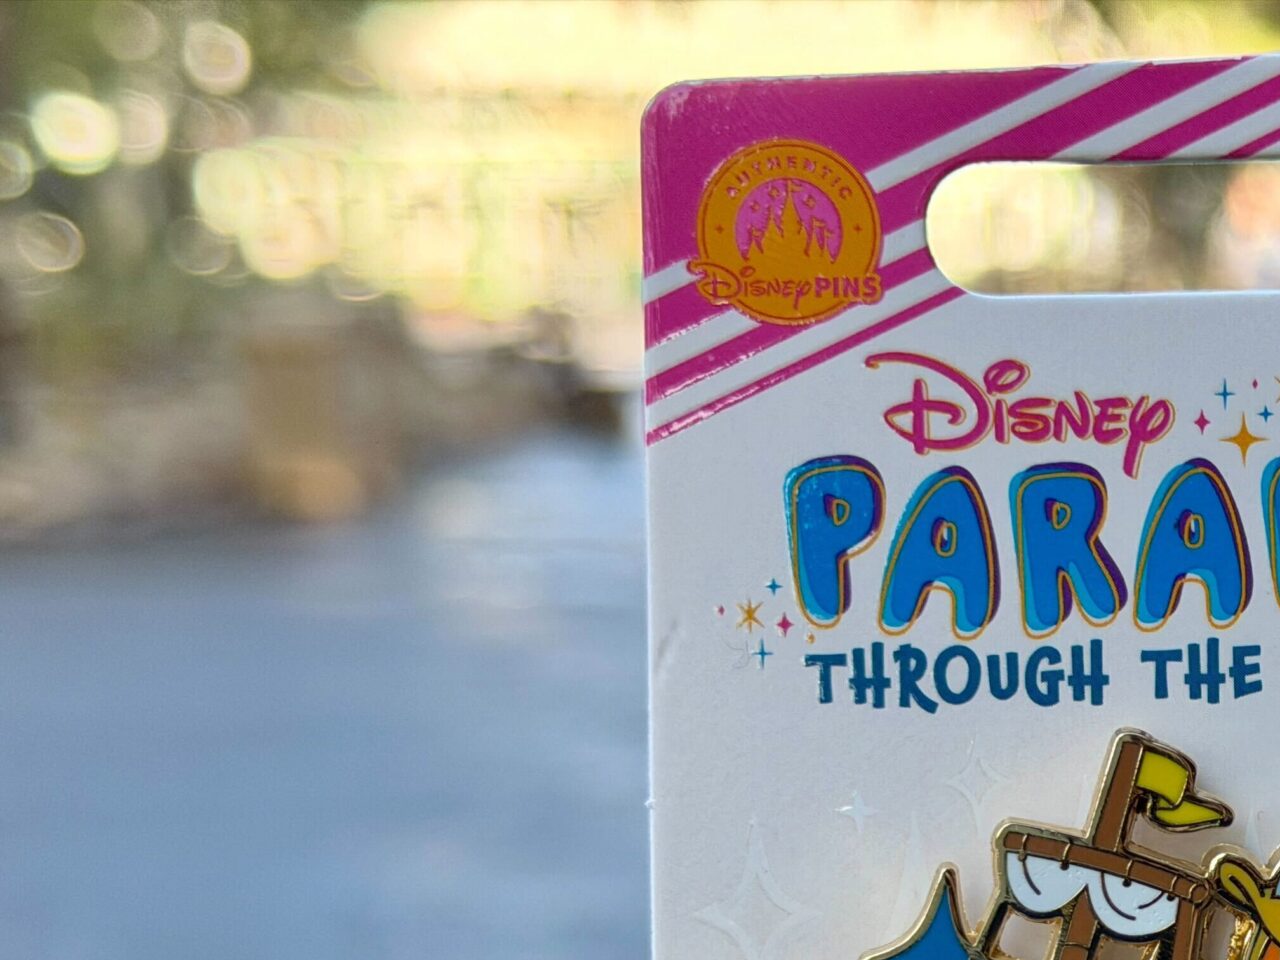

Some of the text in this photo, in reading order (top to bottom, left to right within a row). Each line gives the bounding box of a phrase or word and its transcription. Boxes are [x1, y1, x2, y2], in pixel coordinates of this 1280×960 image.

[726, 156, 853, 200] AUTHENTIC
[814, 276, 878, 298] PINS
[804, 636, 1110, 714] THROUGH
[1140, 637, 1264, 706] THE
